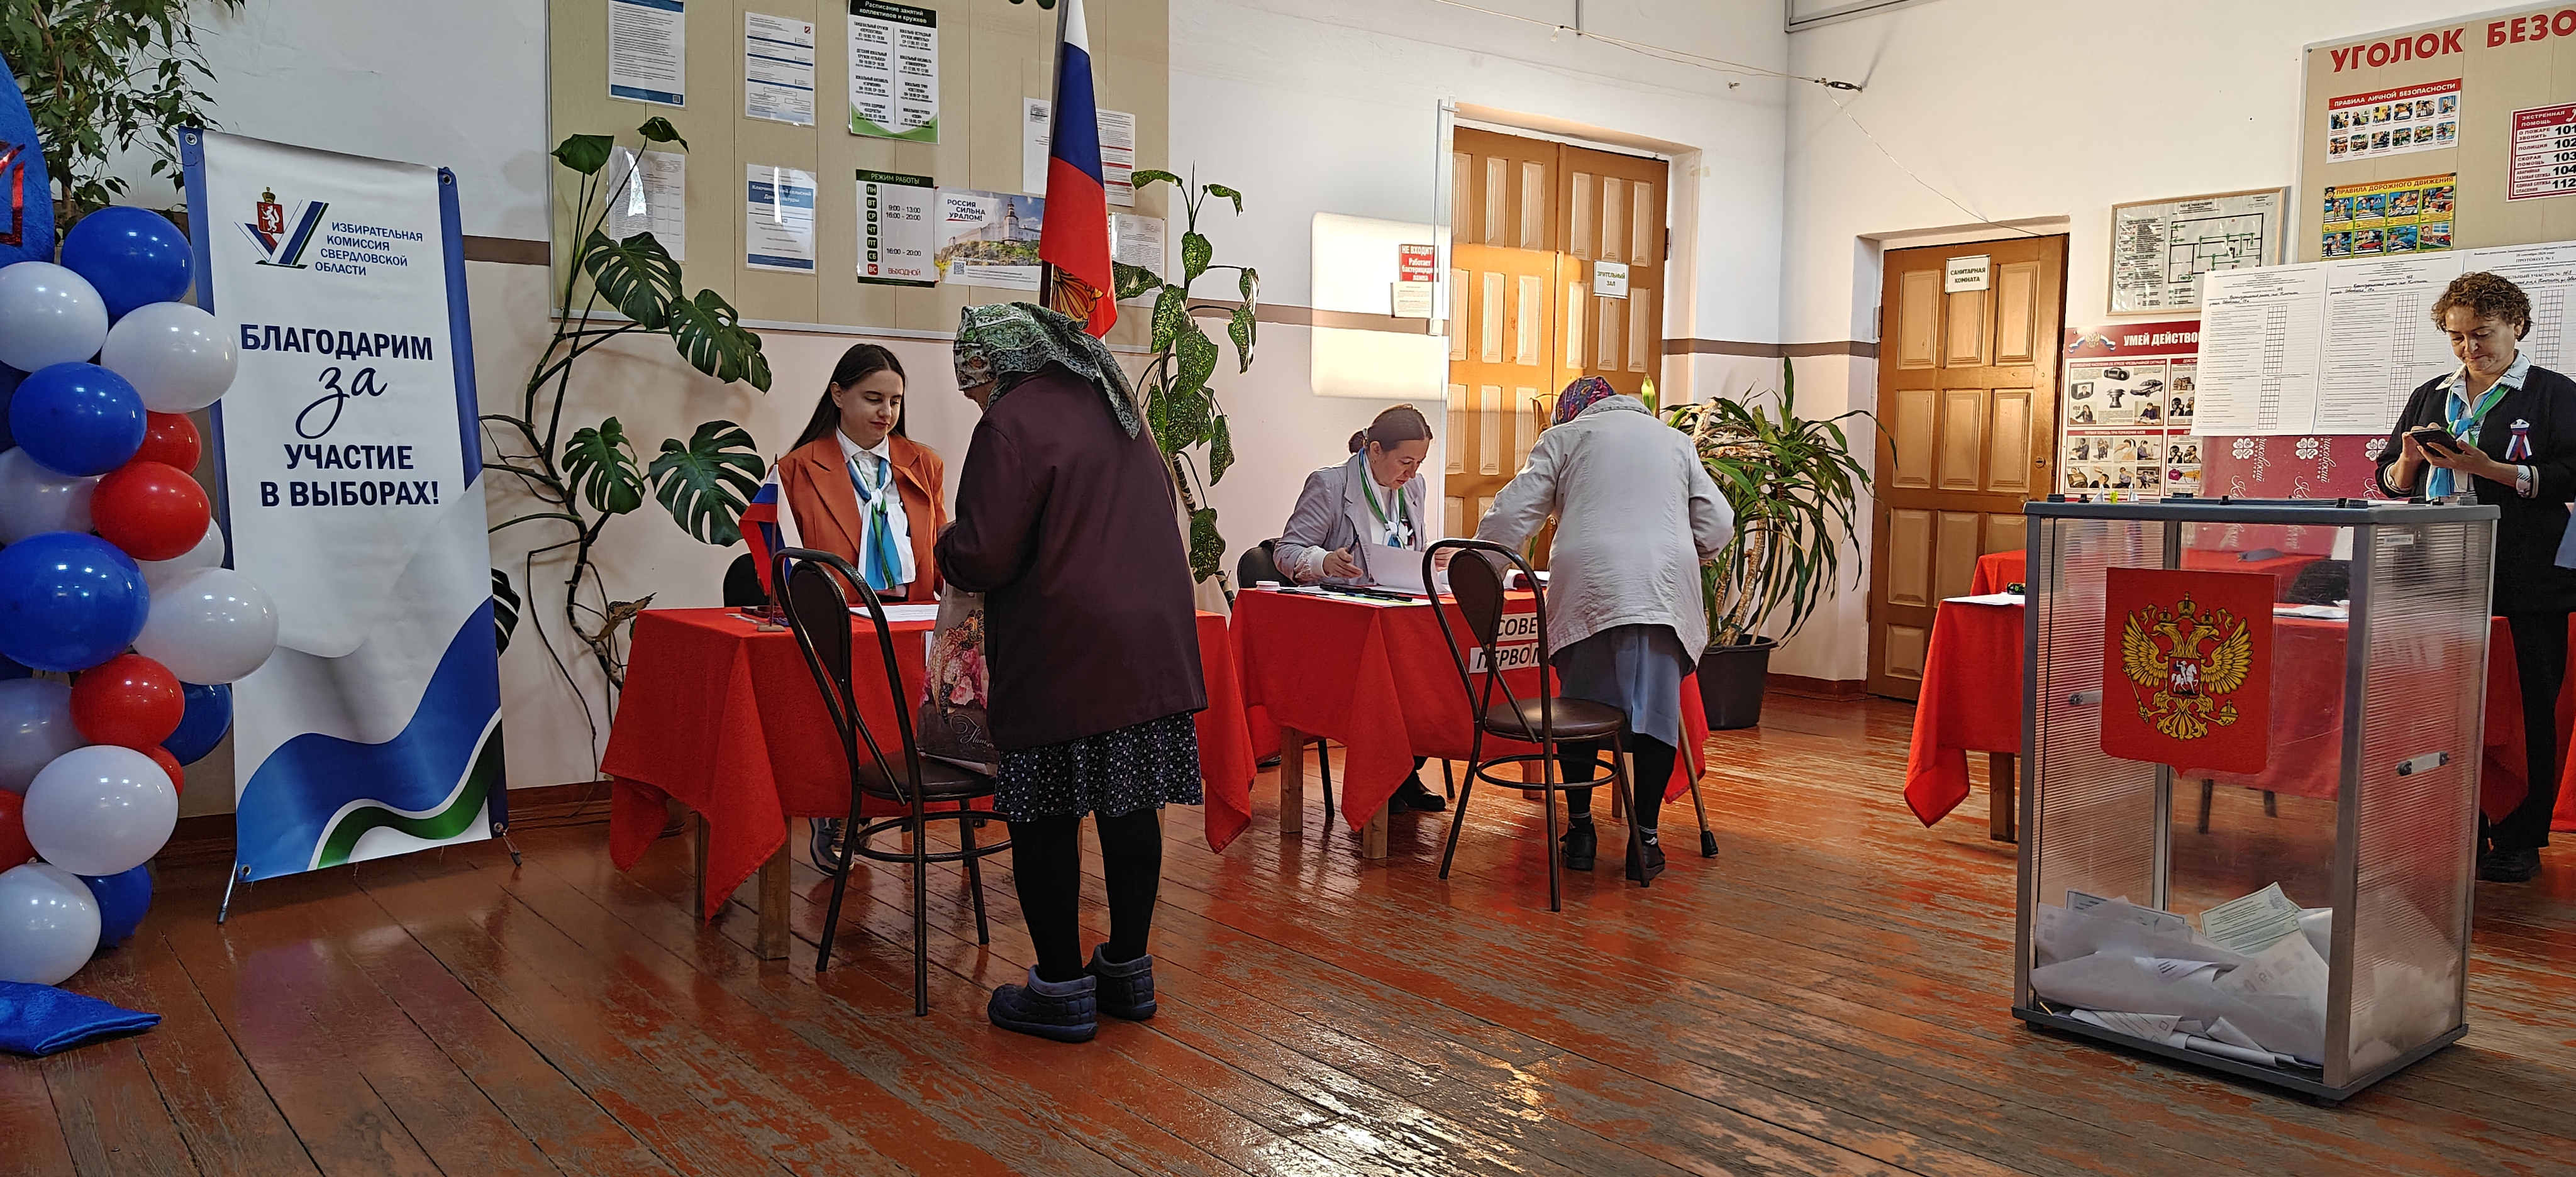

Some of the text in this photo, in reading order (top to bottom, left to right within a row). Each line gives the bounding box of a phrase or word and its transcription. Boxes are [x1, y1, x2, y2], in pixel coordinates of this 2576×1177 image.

[865, 1, 924, 16] Расписание занятий
[859, 8, 897, 19] коллективов
[903, 16, 927, 24] кружков
[2330, 9, 2576, 73] УГОЛОК БЕЗО
[2334, 83, 2456, 107] ПРАВИЛА ЛИЧНОЙ БЕЗОПАСНОСТИ
[2521, 111, 2565, 121] ЭКСТРЕННАЯ
[2555, 124, 2576, 135] 101
[2518, 138, 2576, 151] ПОЛИЦИЯ 102
[2553, 151, 2576, 162] 103
[2553, 164, 2576, 175] 104
[871, 173, 919, 184] РЕЖИМ РАБОТЫ
[2552, 178, 2576, 189] 112
[2336, 177, 2453, 195] ПРАВИЛА ДОРОЖНОГО ДВИЖЕНИЯ
[947, 199, 976, 208] РОССИЯ
[949, 212, 982, 222] УРАЛОМ!
[956, 206, 986, 216] СИЛЬНА
[332, 221, 423, 242] ИЗБИРАТЕЛЬНАЯ
[327, 235, 390, 251] КОМИССИЯ
[321, 248, 408, 267] СВЕРДЛОВСКОЙ
[1402, 245, 1435, 257] НЕ ВХОДИТ
[315, 262, 367, 276] ОБЛАСТИ
[1408, 257, 1432, 267] Работает
[1950, 267, 1986, 275] САНИТАРНАЯ
[240, 324, 433, 361] БЛАГОДАРИМ
[2123, 331, 2199, 346] УМЕЙ ДЕЙСТВО
[295, 367, 388, 439] за
[284, 444, 414, 470] УЧАСТИЕ
[260, 480, 440, 507] В ВЫБОРАХ!
